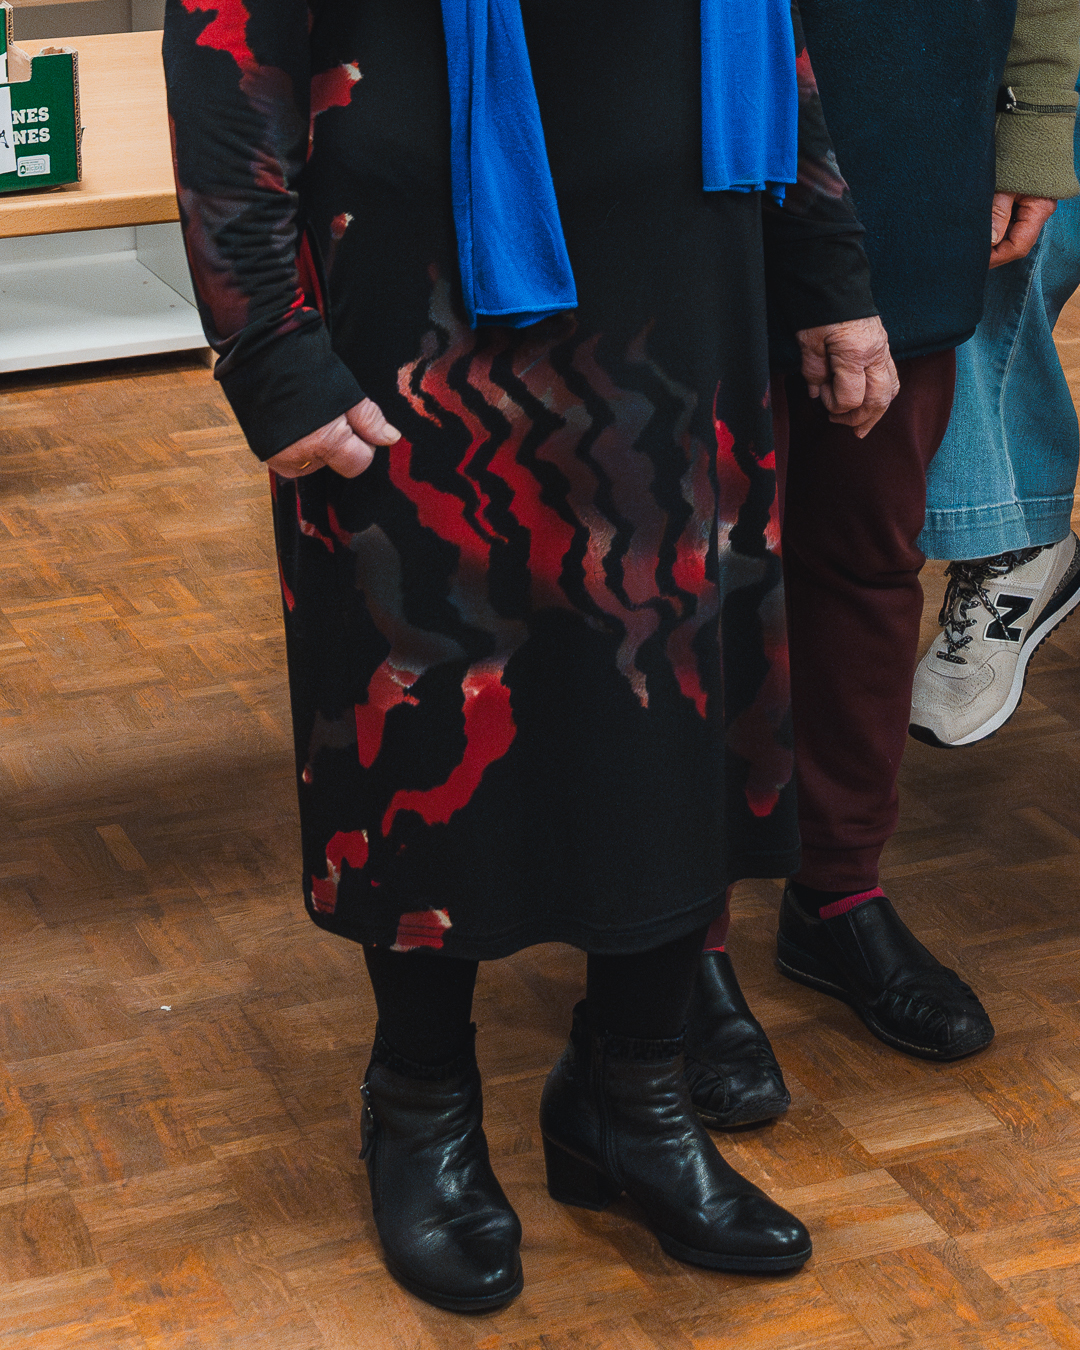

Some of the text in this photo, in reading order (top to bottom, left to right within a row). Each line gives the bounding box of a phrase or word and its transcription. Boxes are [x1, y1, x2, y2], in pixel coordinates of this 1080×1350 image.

[11, 106, 50, 125] NES
[13, 127, 51, 146] NES
[983, 593, 1034, 643] N
